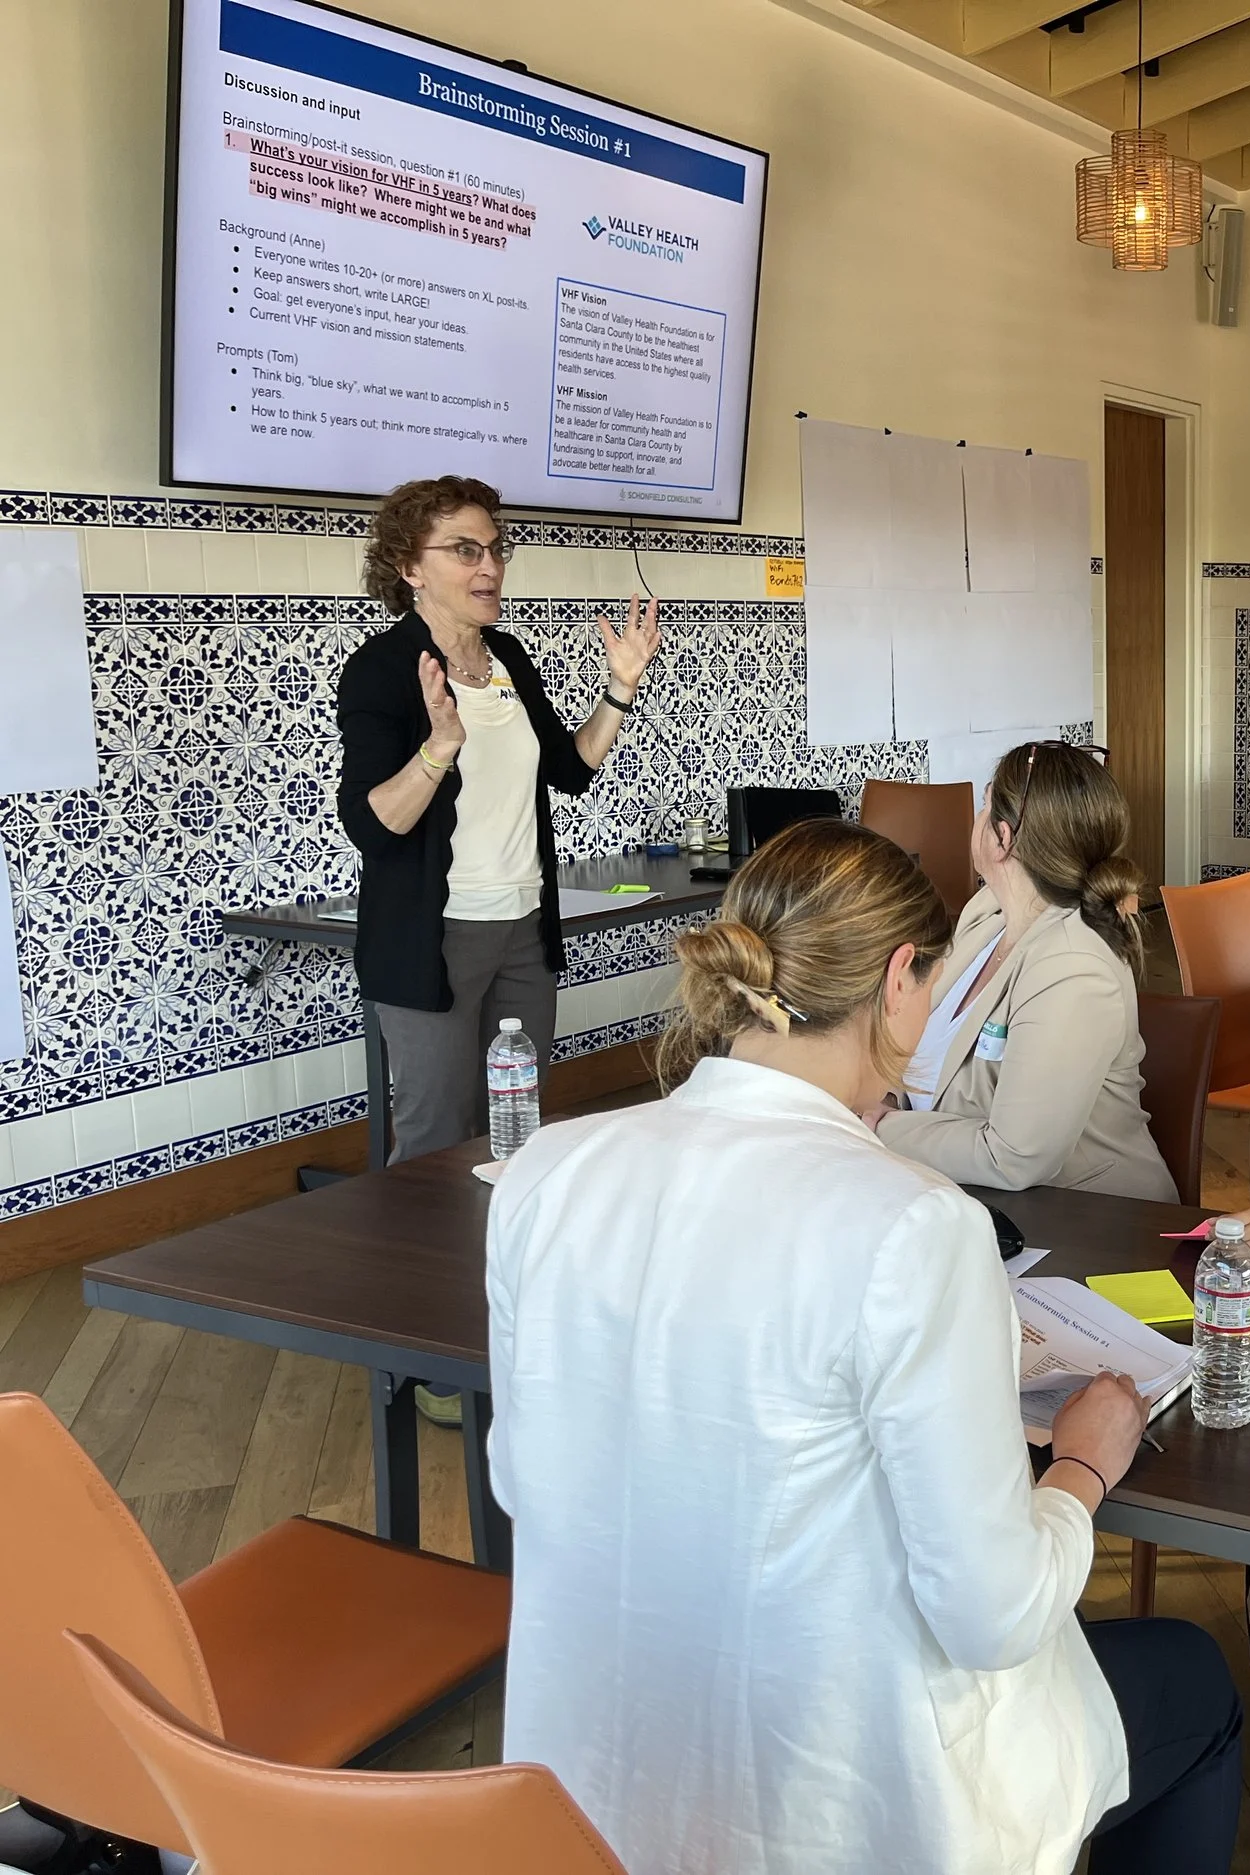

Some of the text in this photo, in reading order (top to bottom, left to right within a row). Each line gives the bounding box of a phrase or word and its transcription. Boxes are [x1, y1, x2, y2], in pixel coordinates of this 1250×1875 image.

[224, 71, 360, 120] Discussion and input
[418, 72, 631, 157] Brainstorming Session #1
[222, 110, 524, 202] Brainstorming/post-it session, question #1 (60 minutes)
[250, 137, 294, 163] What's
[298, 152, 328, 171] your
[330, 159, 367, 181] vision
[371, 167, 388, 186] for
[390, 172, 415, 193] VHF
[418, 179, 429, 196] in
[432, 183, 439, 198] 5
[441, 188, 479, 207] years?
[481, 195, 508, 213] What
[511, 204, 536, 220] does
[249, 161, 530, 237] success look like? Where might we be and what
[249, 178, 506, 248] "big wins" might we accomplish in 5 years?
[219, 218, 325, 252] Background (Anne)
[607, 232, 683, 263] FOUNDATION
[608, 215, 698, 251] VALLEY HEALTH
[253, 266, 429, 308] Keep answers short, write LARGE!
[254, 245, 305, 266] Everyone
[308, 258, 339, 272] writes
[343, 263, 377, 279] 10-20+
[380, 271, 395, 284] (or
[397, 276, 425, 291] more)
[427, 282, 466, 297] answers
[467, 290, 479, 300] on
[482, 290, 494, 303] XL
[253, 286, 468, 334] Goal: get everyone's input, hear your ideas.
[561, 287, 606, 306] VHF Vision
[249, 306, 466, 352] Current VHF vision and mission statements.
[559, 317, 699, 353] Santa Clara County to be the healthiest
[560, 301, 715, 341] The vision of Valley Health Foundation is for
[216, 341, 298, 366] Prompts (Tom)
[557, 361, 616, 379] health services.
[251, 366, 281, 381] Think
[285, 371, 304, 386] big,
[363, 383, 386, 395] what
[388, 388, 403, 397] we
[405, 390, 428, 400] want
[430, 392, 439, 402] to
[441, 395, 491, 408] accomplish
[493, 399, 501, 410] in
[503, 401, 509, 411] 5
[251, 387, 284, 398] years.
[556, 384, 607, 401] VHF Mission
[250, 424, 314, 438] we are now.
[251, 404, 276, 417] How
[279, 408, 289, 419] to
[292, 409, 317, 422] think
[320, 412, 327, 423] 5
[329, 415, 357, 426] years
[381, 419, 404, 431] think
[406, 424, 430, 434] more
[432, 427, 485, 443] strategically
[487, 433, 499, 442] vs.
[502, 433, 527, 445] where
[555, 398, 571, 410] The
[572, 403, 601, 414] mission
[603, 406, 611, 415] of
[612, 407, 634, 419] Valley
[635, 410, 658, 422] Health
[659, 413, 697, 427] Foundation
[705, 421, 712, 429] to
[552, 457, 587, 469] advocate
[588, 460, 610, 471] better
[611, 462, 634, 473] health
[635, 464, 645, 474] for
[1016, 1287, 1070, 1325] Brainstorming
[1070, 1320, 1100, 1342] Session
